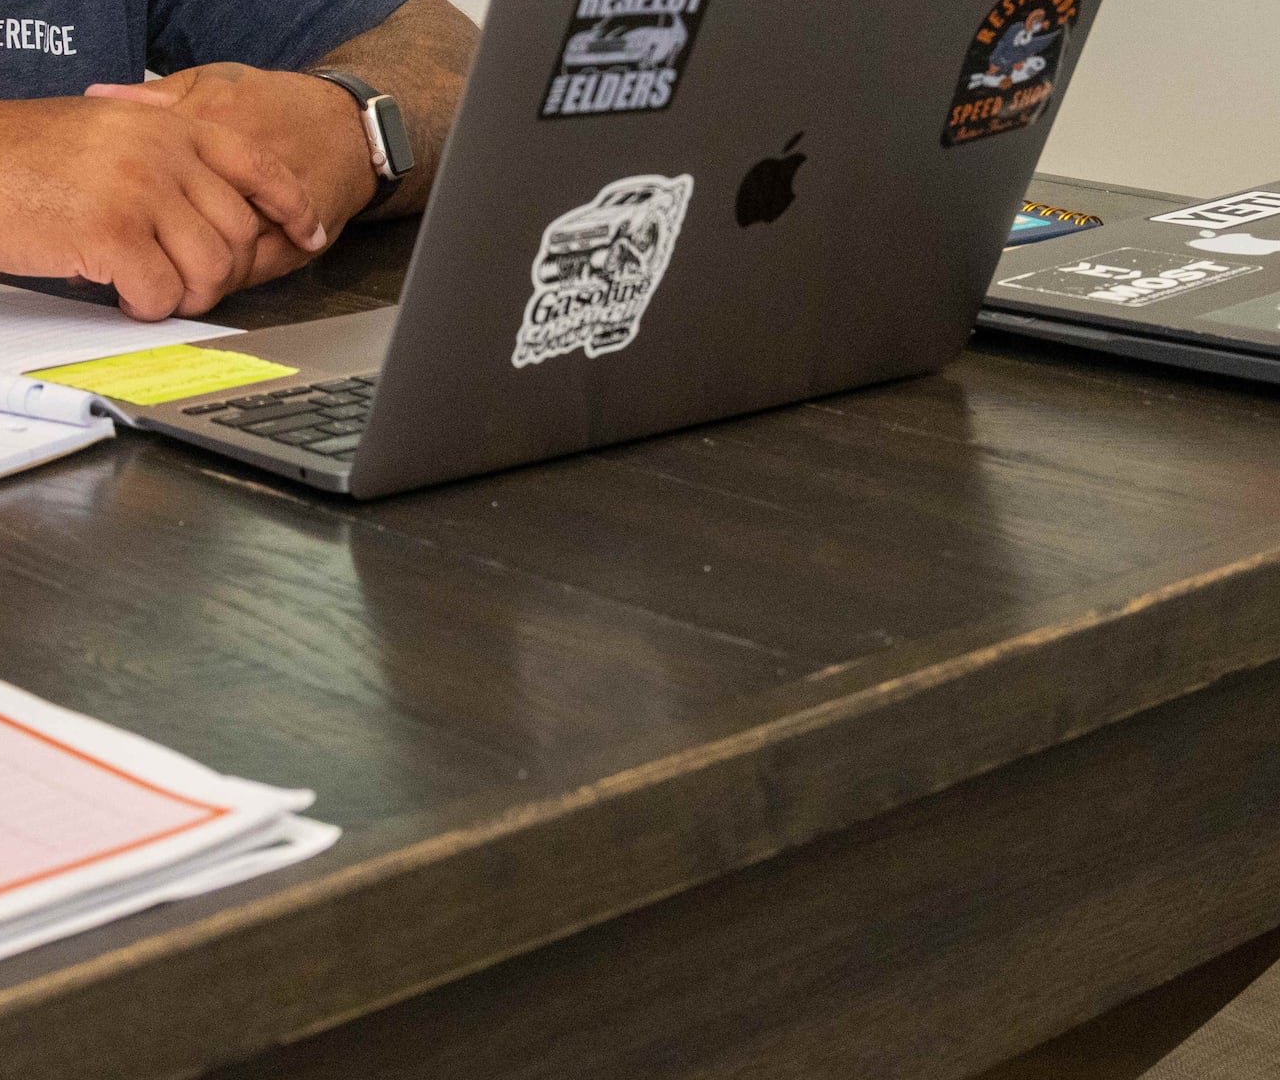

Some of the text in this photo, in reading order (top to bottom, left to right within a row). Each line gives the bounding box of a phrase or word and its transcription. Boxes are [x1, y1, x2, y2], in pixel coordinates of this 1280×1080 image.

[6, 18, 77, 56] REFUGE
[561, 69, 678, 115] ELDERS
[950, 96, 1003, 127] SPEED
[531, 278, 652, 325] Gasoline
[1087, 260, 1230, 302] MOST
